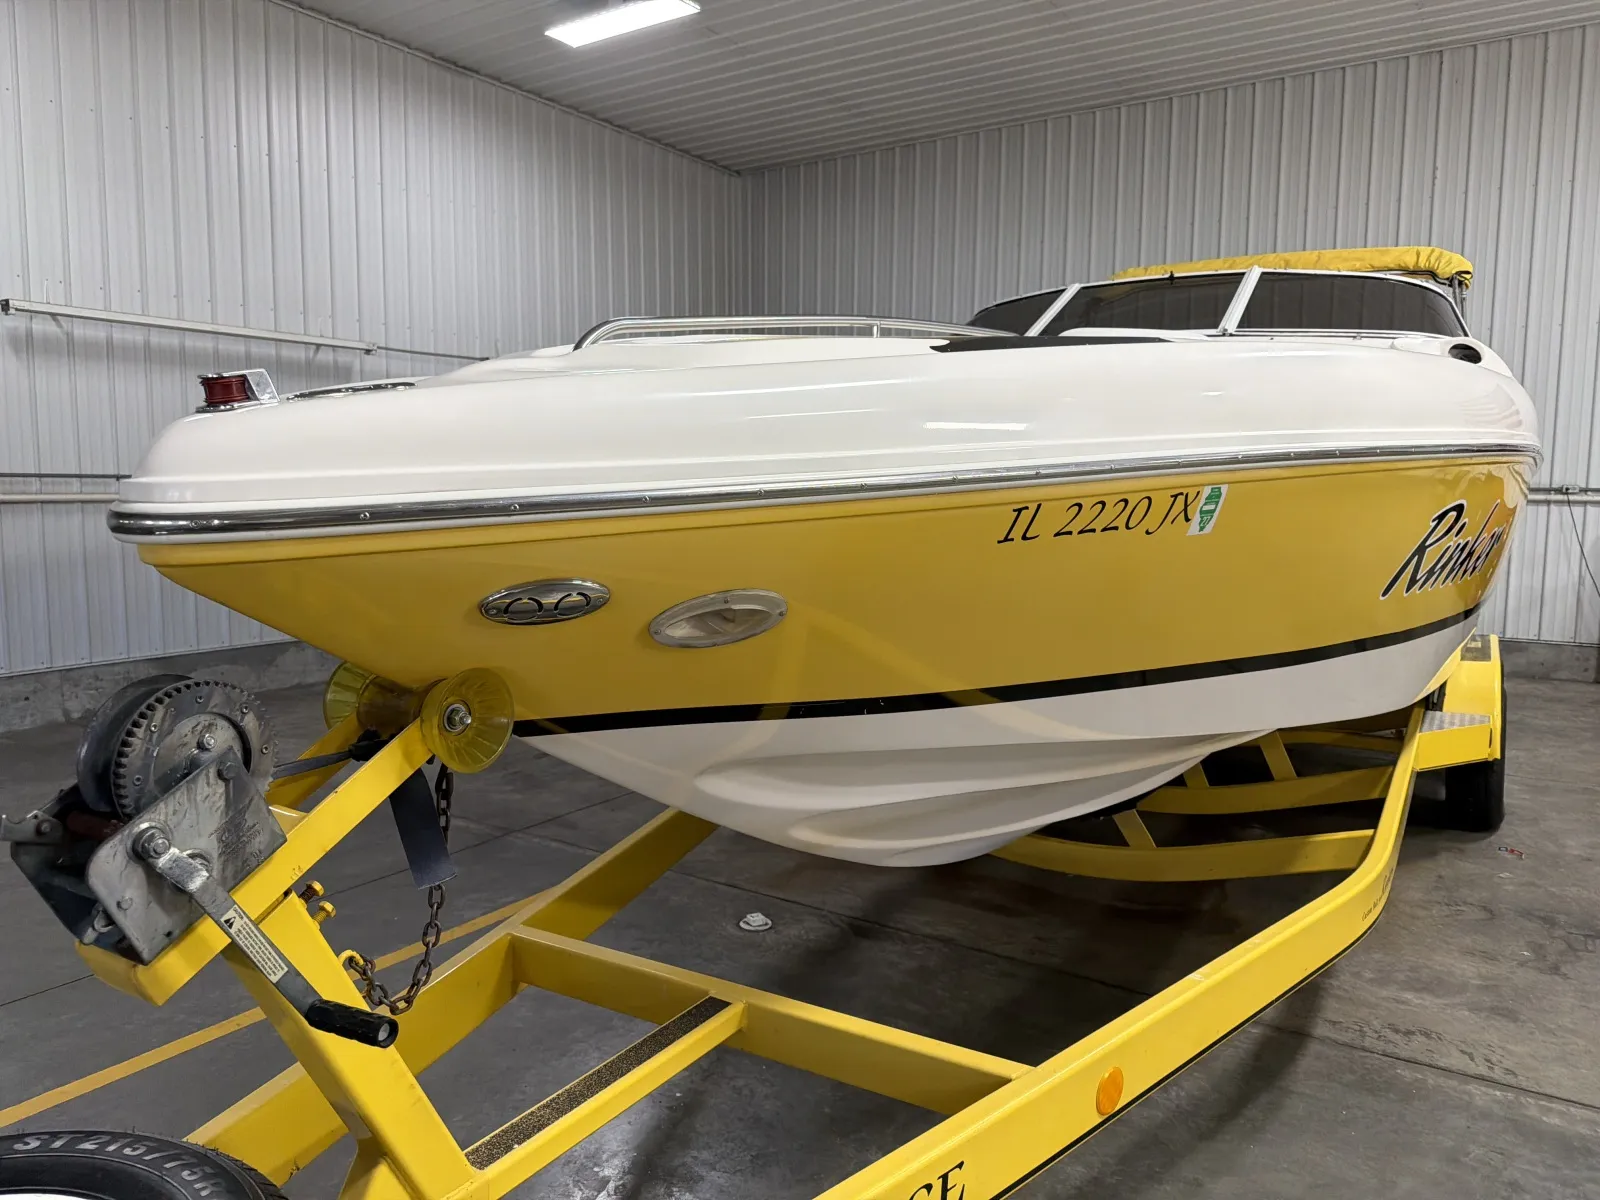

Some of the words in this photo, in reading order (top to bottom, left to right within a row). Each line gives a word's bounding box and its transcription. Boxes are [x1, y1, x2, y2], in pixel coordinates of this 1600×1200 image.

[997, 503, 1042, 544] IL
[1053, 496, 1153, 538] 2220
[1145, 491, 1201, 536] JX
